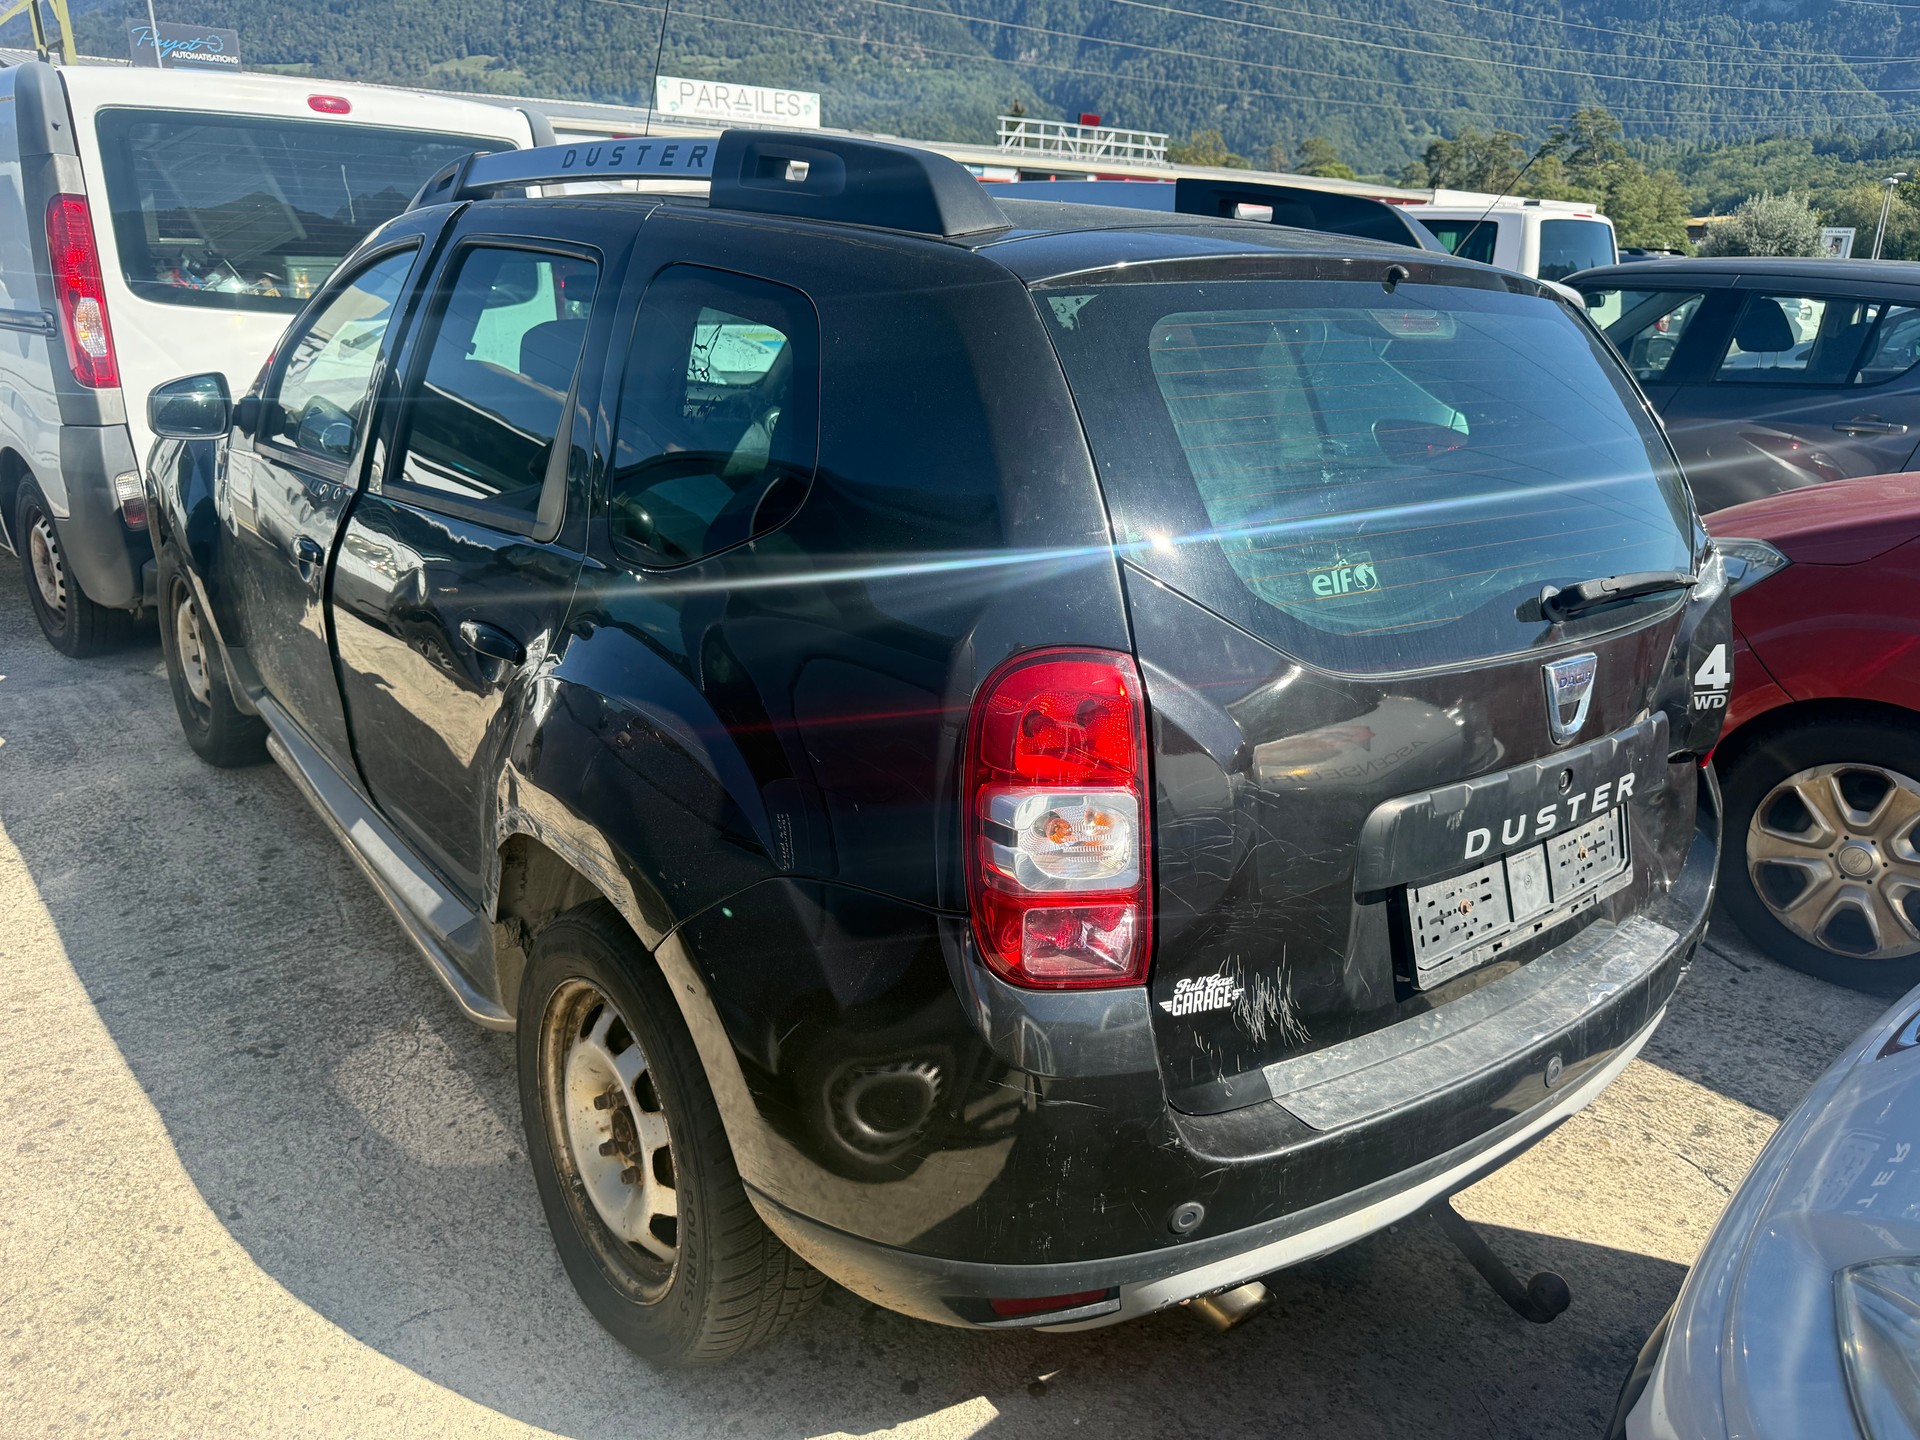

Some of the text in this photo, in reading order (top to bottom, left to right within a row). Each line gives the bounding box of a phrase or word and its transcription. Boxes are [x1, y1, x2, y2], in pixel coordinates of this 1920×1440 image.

[171, 50, 239, 64] AUTOMATISATIONS
[562, 145, 709, 169] DUSTER
[1312, 568, 1352, 597] elf
[1559, 671, 1592, 689] DACIA
[1694, 644, 1731, 690] 4
[1694, 694, 1727, 711] WD
[1464, 772, 1636, 860] DUSTER
[1174, 976, 1205, 994] Full
[1172, 985, 1232, 1017] GARAGE
[684, 1188, 698, 1302] POLARIS
